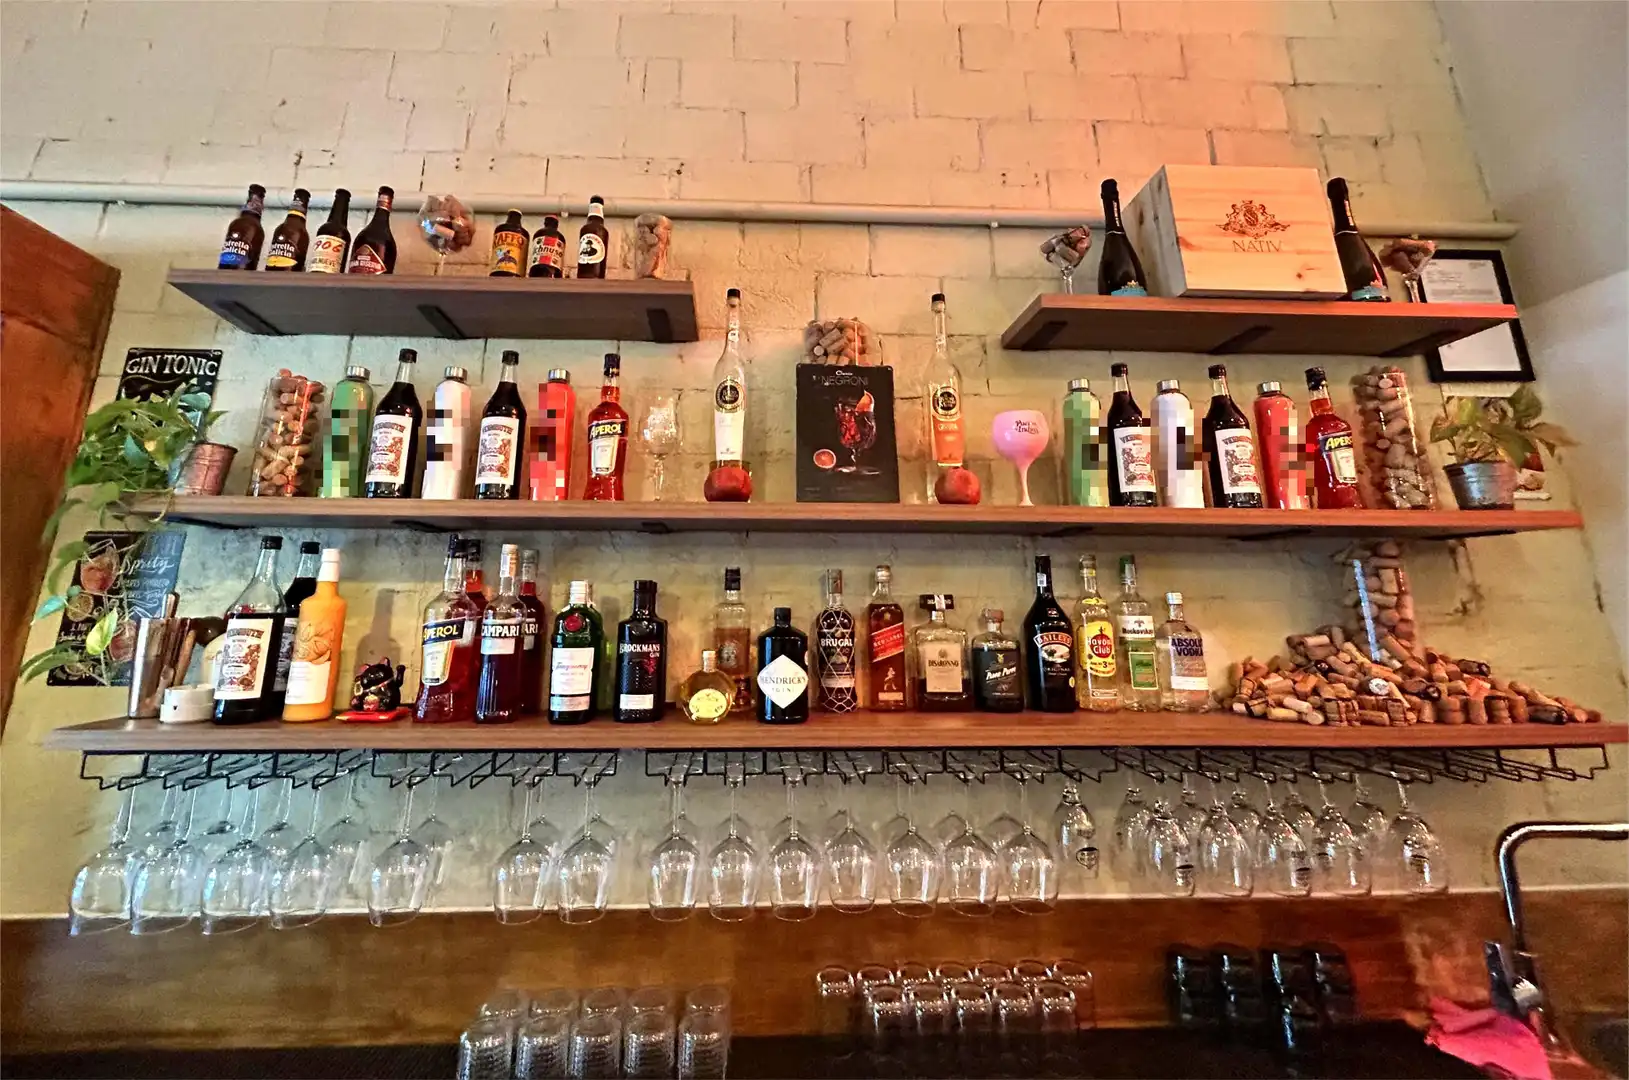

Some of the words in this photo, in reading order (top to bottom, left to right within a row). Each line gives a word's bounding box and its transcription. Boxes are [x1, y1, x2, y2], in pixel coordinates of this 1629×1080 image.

[1232, 240, 1283, 253] NATIV
[125, 355, 161, 374] GIN
[163, 354, 218, 376] TONIC
[821, 375, 869, 386] NEGRONI
[590, 424, 622, 440] APEROL
[820, 638, 853, 647] BRUGAL
[1037, 633, 1071, 644] BAILEYS
[619, 643, 660, 654] BROCKMANS
[1093, 645, 1111, 655] Club
